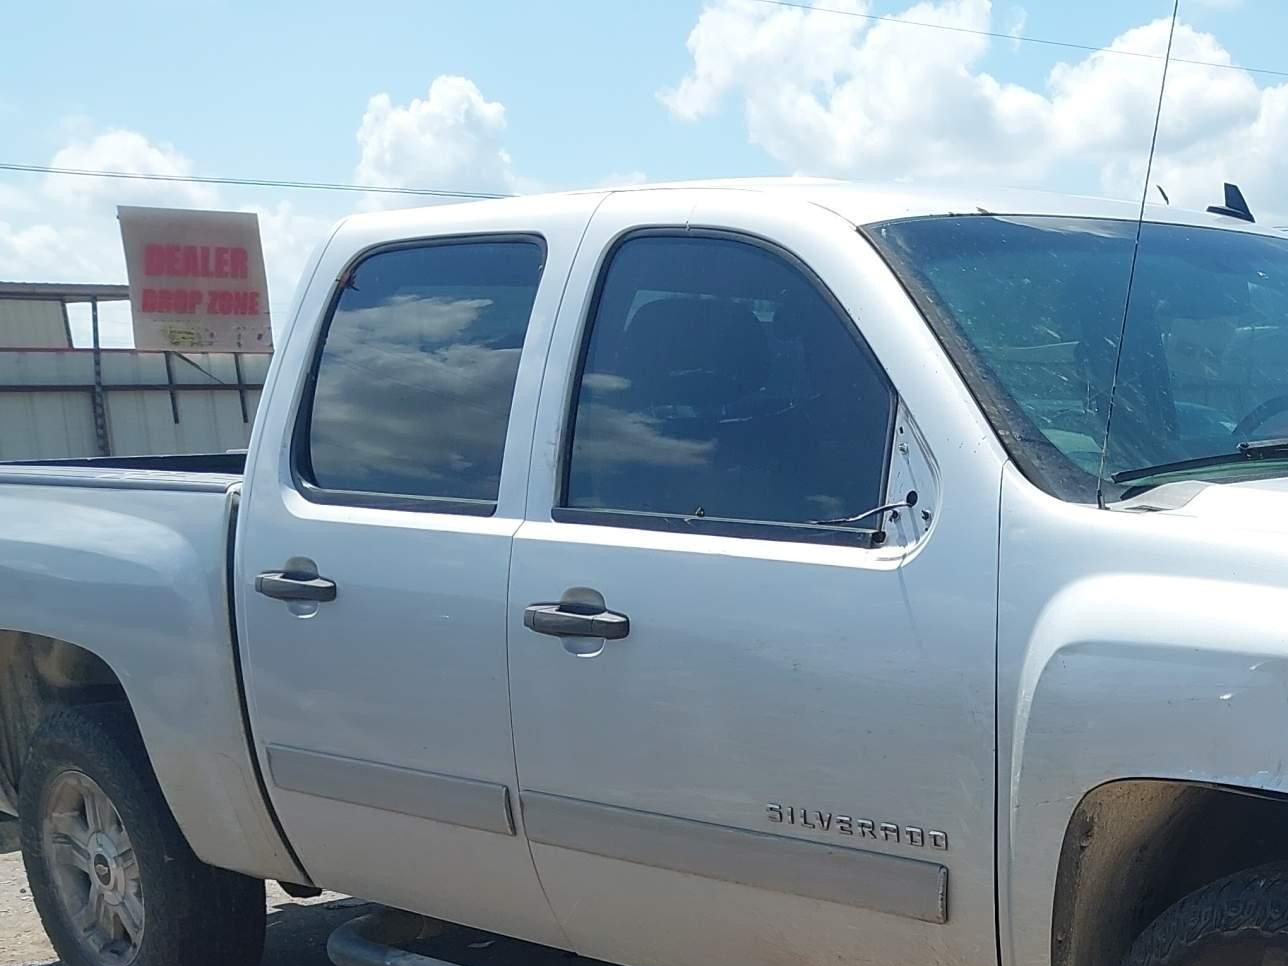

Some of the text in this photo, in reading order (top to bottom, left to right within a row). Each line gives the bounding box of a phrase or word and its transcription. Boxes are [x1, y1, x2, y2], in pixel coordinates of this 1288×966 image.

[144, 244, 249, 279] DEALER
[142, 288, 261, 316] DROP ZONE
[766, 802, 949, 851] SILVERADO
